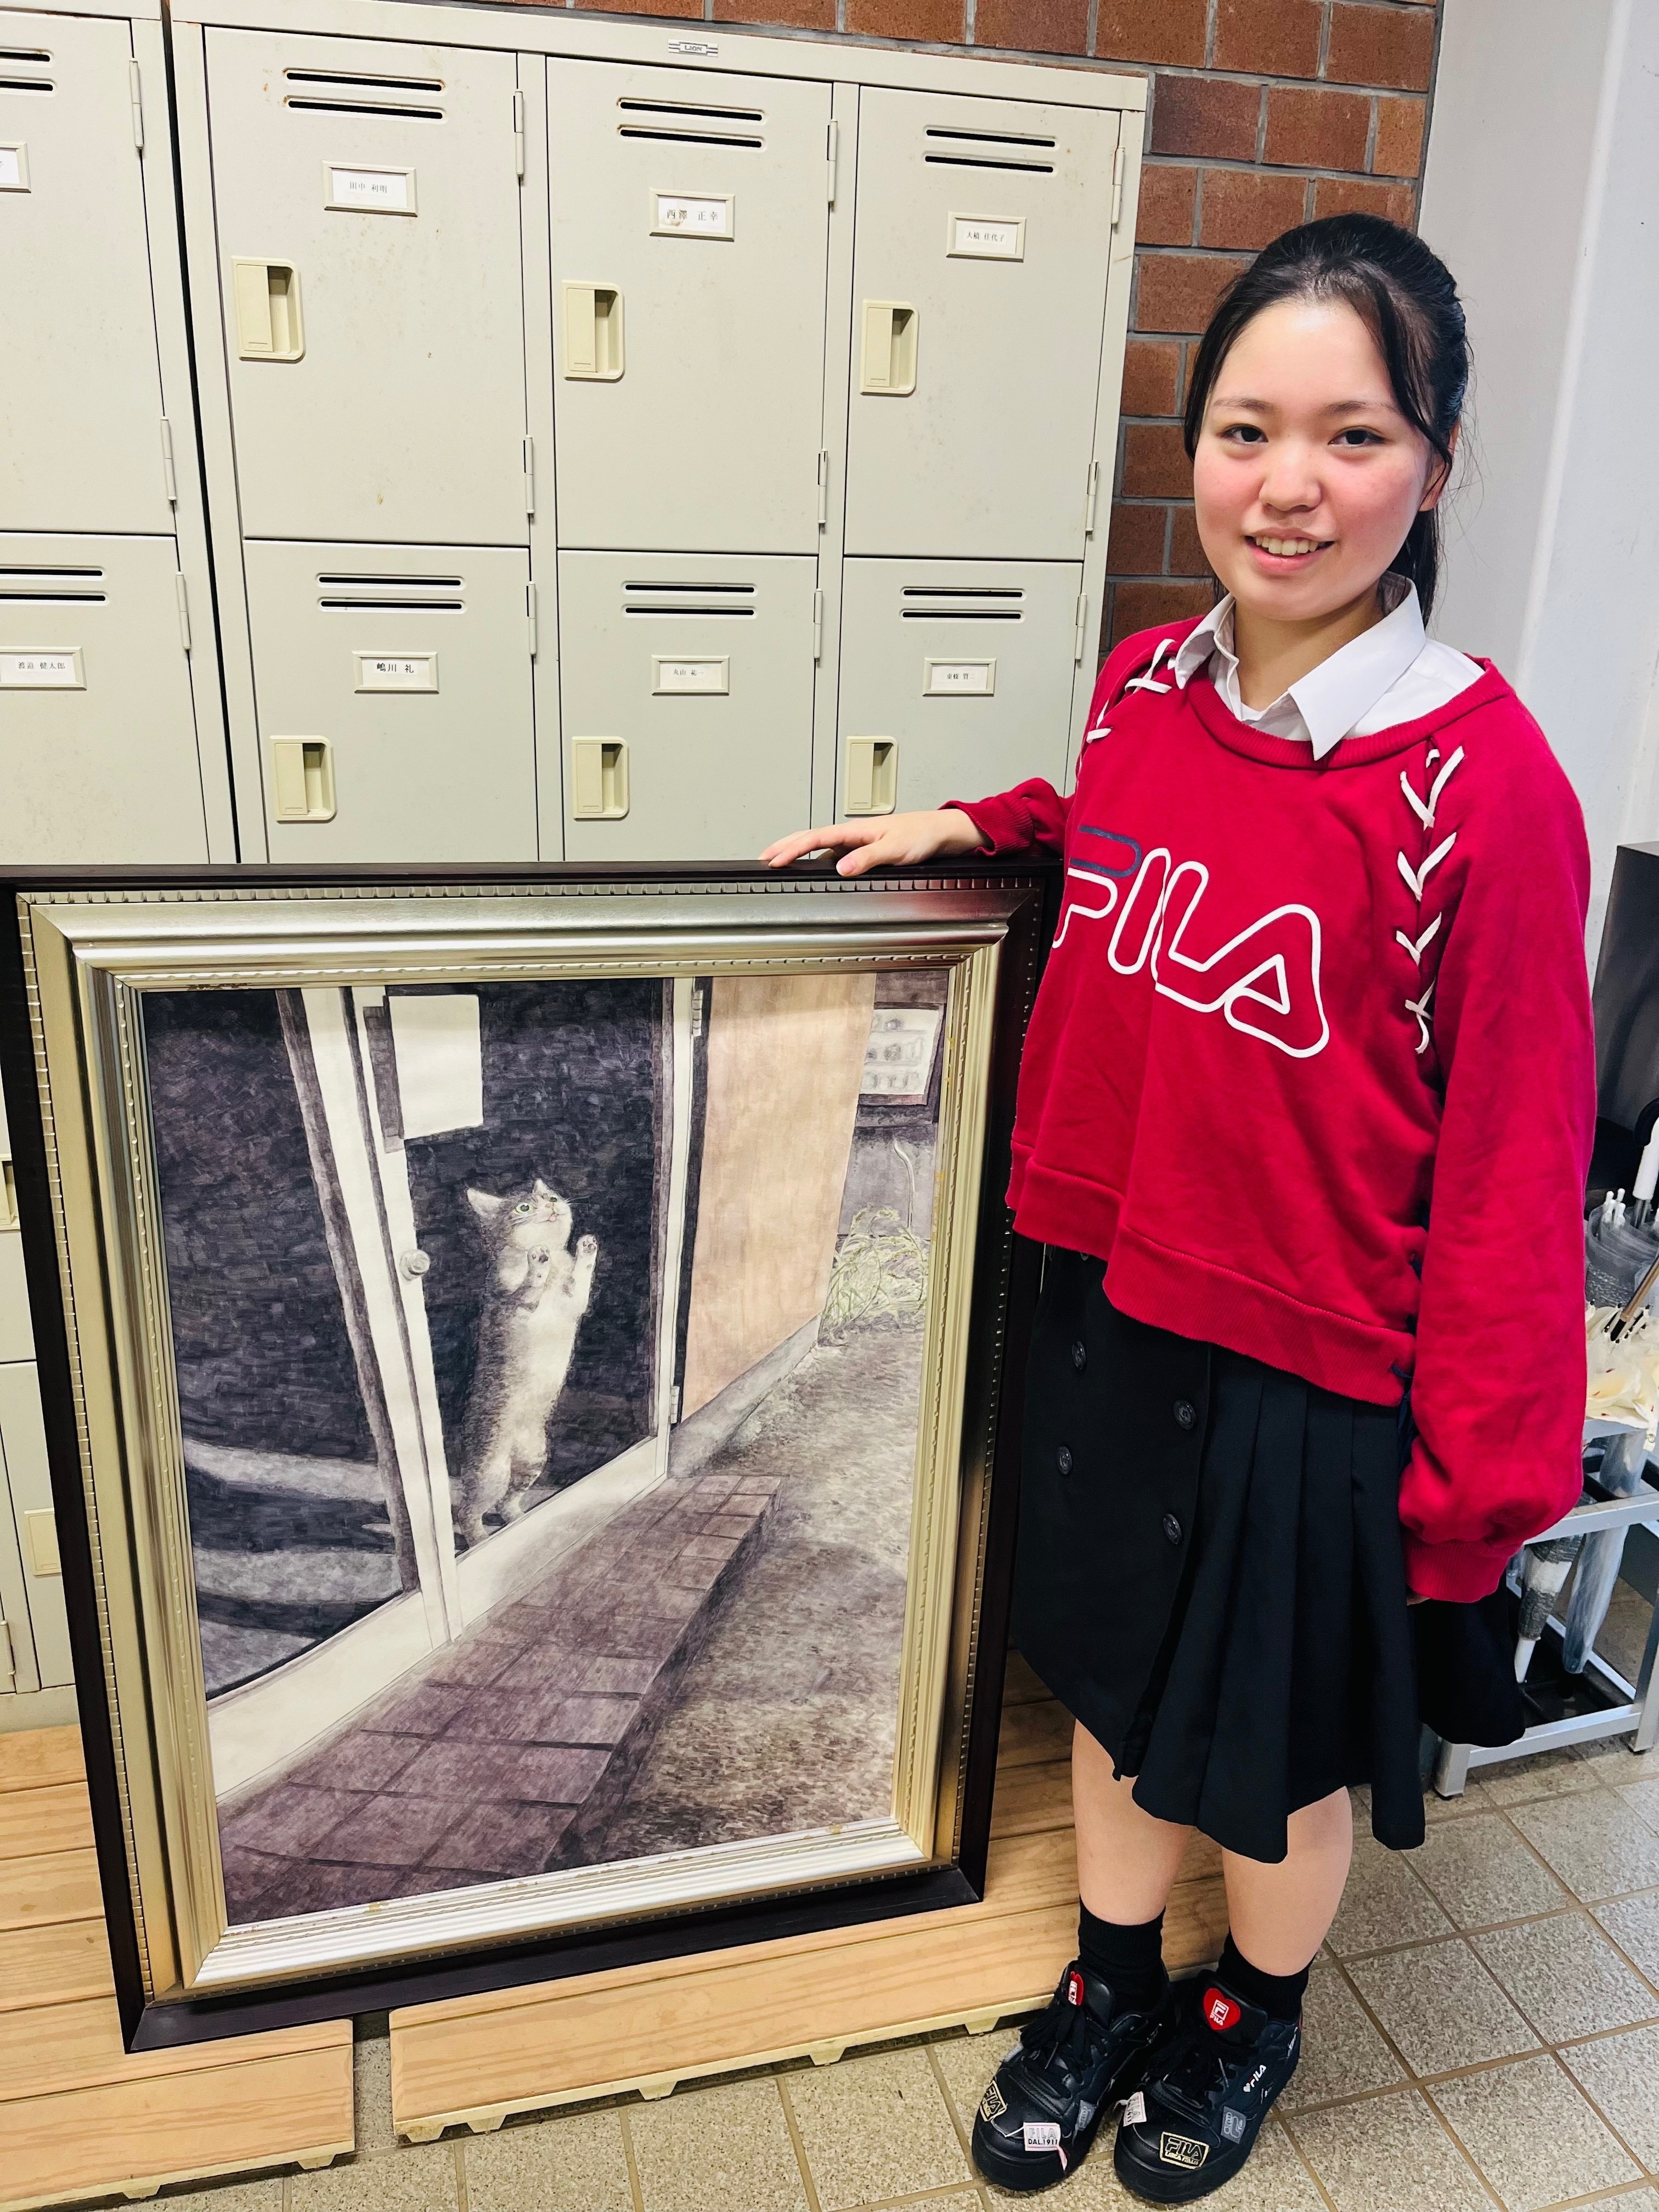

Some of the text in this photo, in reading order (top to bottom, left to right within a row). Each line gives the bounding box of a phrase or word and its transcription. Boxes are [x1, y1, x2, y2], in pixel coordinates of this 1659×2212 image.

[349, 182, 387, 193] 田中 利明
[697, 211, 719, 222] 正幸
[404, 664, 414, 673] 礼
[1052, 825, 1330, 1059] FILA
[1249, 2064, 1267, 2087] FILA
[1029, 2128, 1057, 2139] FILA
[1165, 2137, 1203, 2162] FILA
